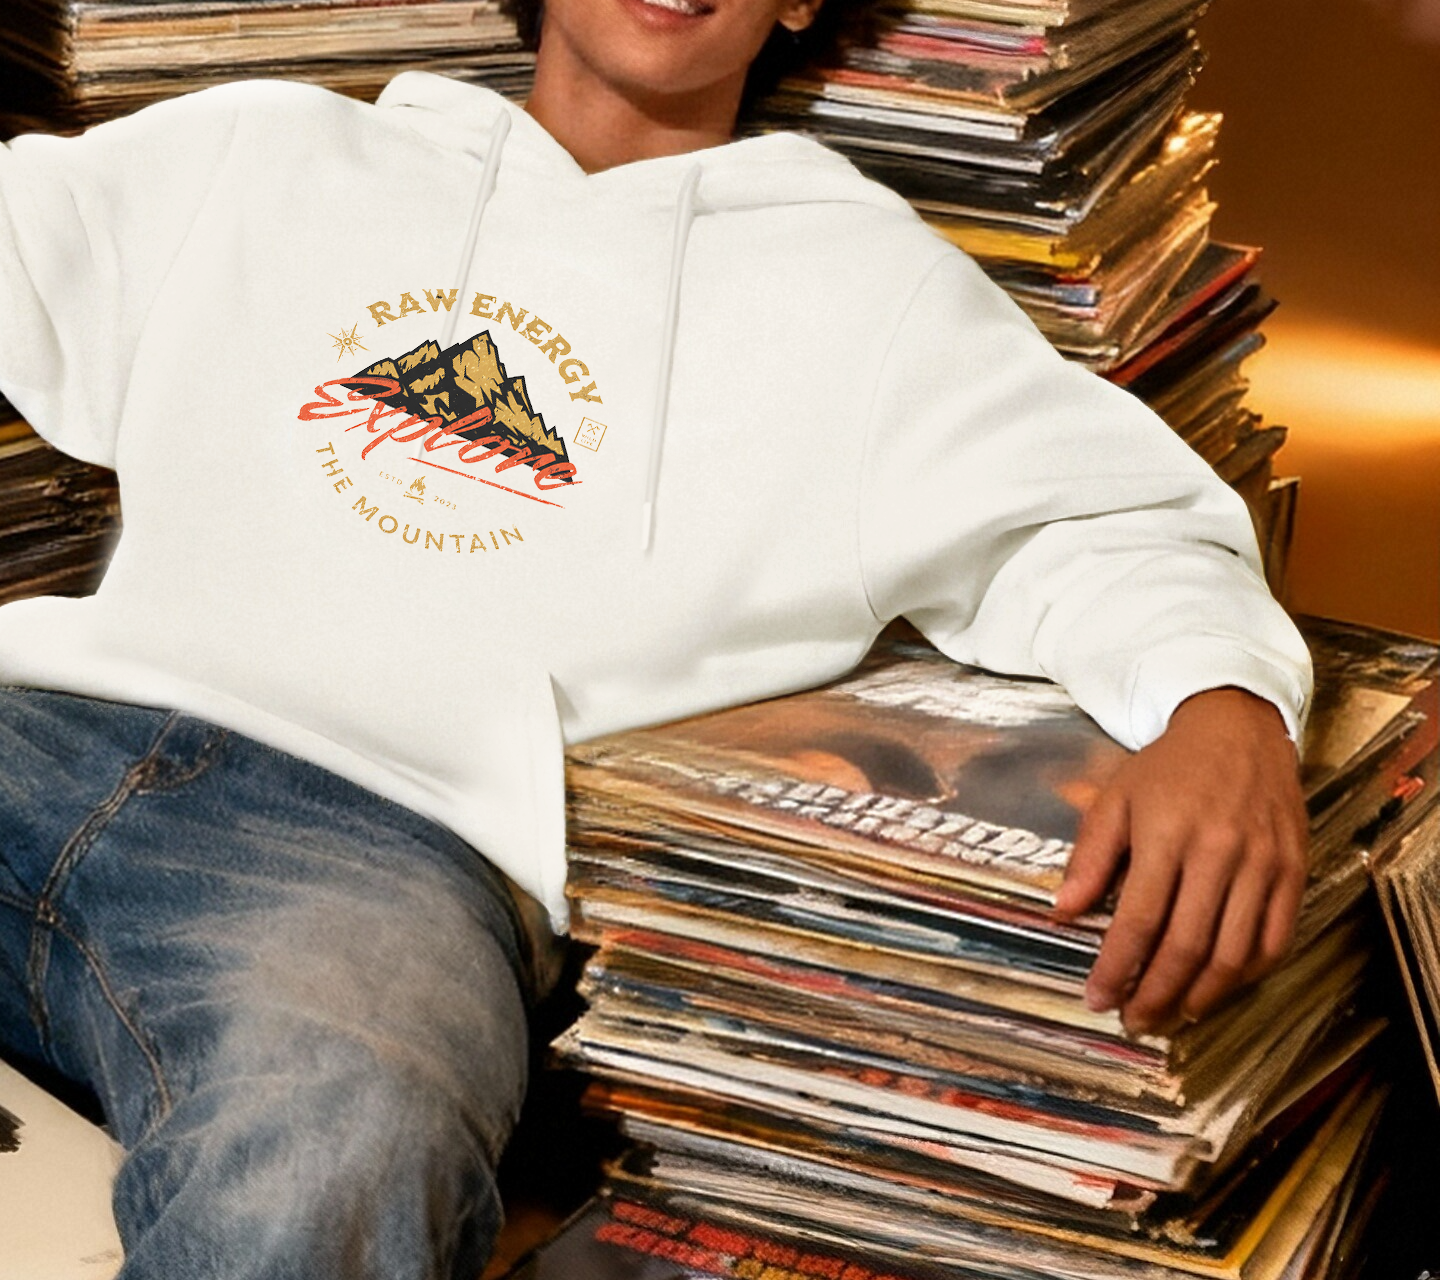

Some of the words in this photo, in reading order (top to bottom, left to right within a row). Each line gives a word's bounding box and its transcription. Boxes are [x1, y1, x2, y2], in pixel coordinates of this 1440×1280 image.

[366, 288, 459, 328] RAW
[469, 291, 603, 404] ENERGY
[297, 376, 583, 490] Explore
[315, 441, 353, 494] THE
[351, 495, 524, 554] MOUNTAIN
[378, 470, 403, 485] ESTD
[433, 495, 457, 510] 2023
